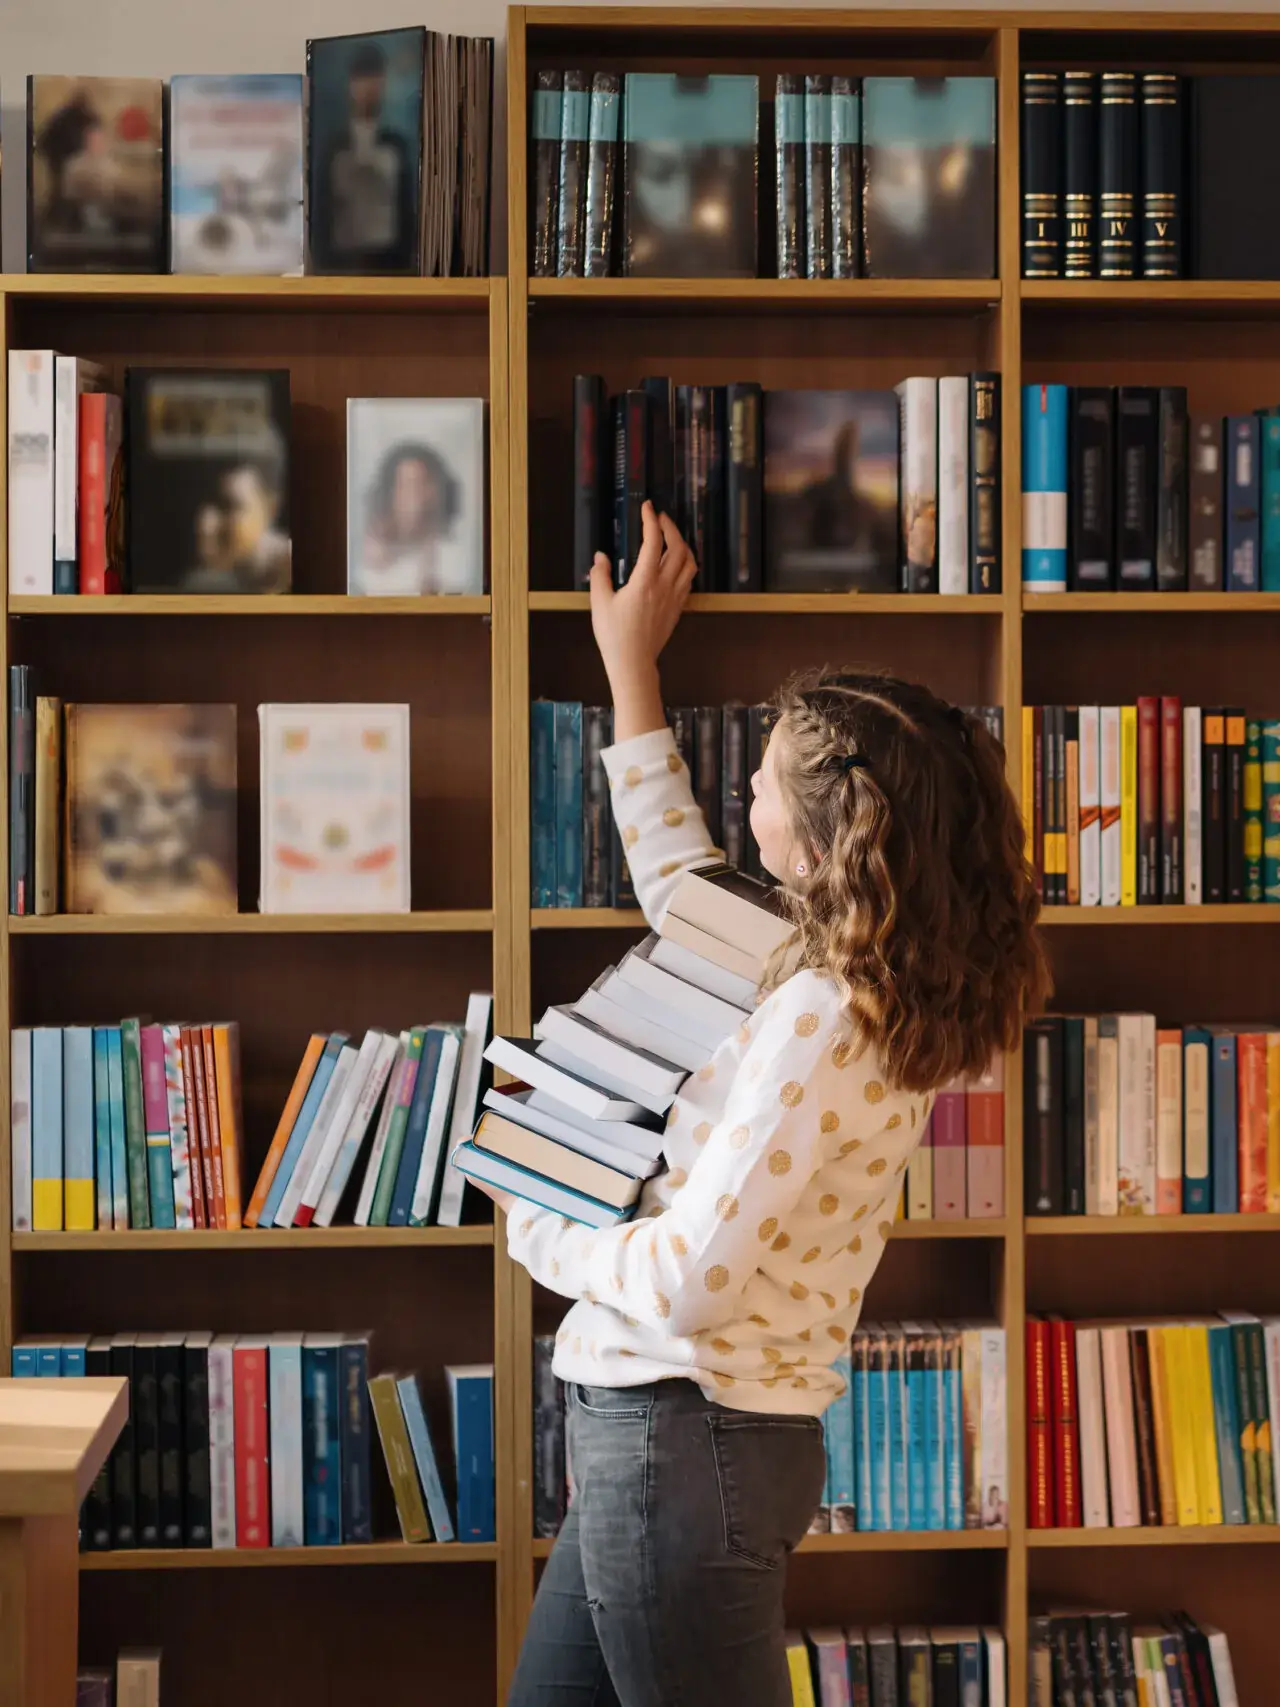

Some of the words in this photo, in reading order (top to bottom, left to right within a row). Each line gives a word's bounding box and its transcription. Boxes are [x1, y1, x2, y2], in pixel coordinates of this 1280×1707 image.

[1038, 222, 1045, 238] I
[1070, 222, 1088, 237] III
[1110, 221, 1127, 237] IV
[1154, 222, 1168, 237] V
